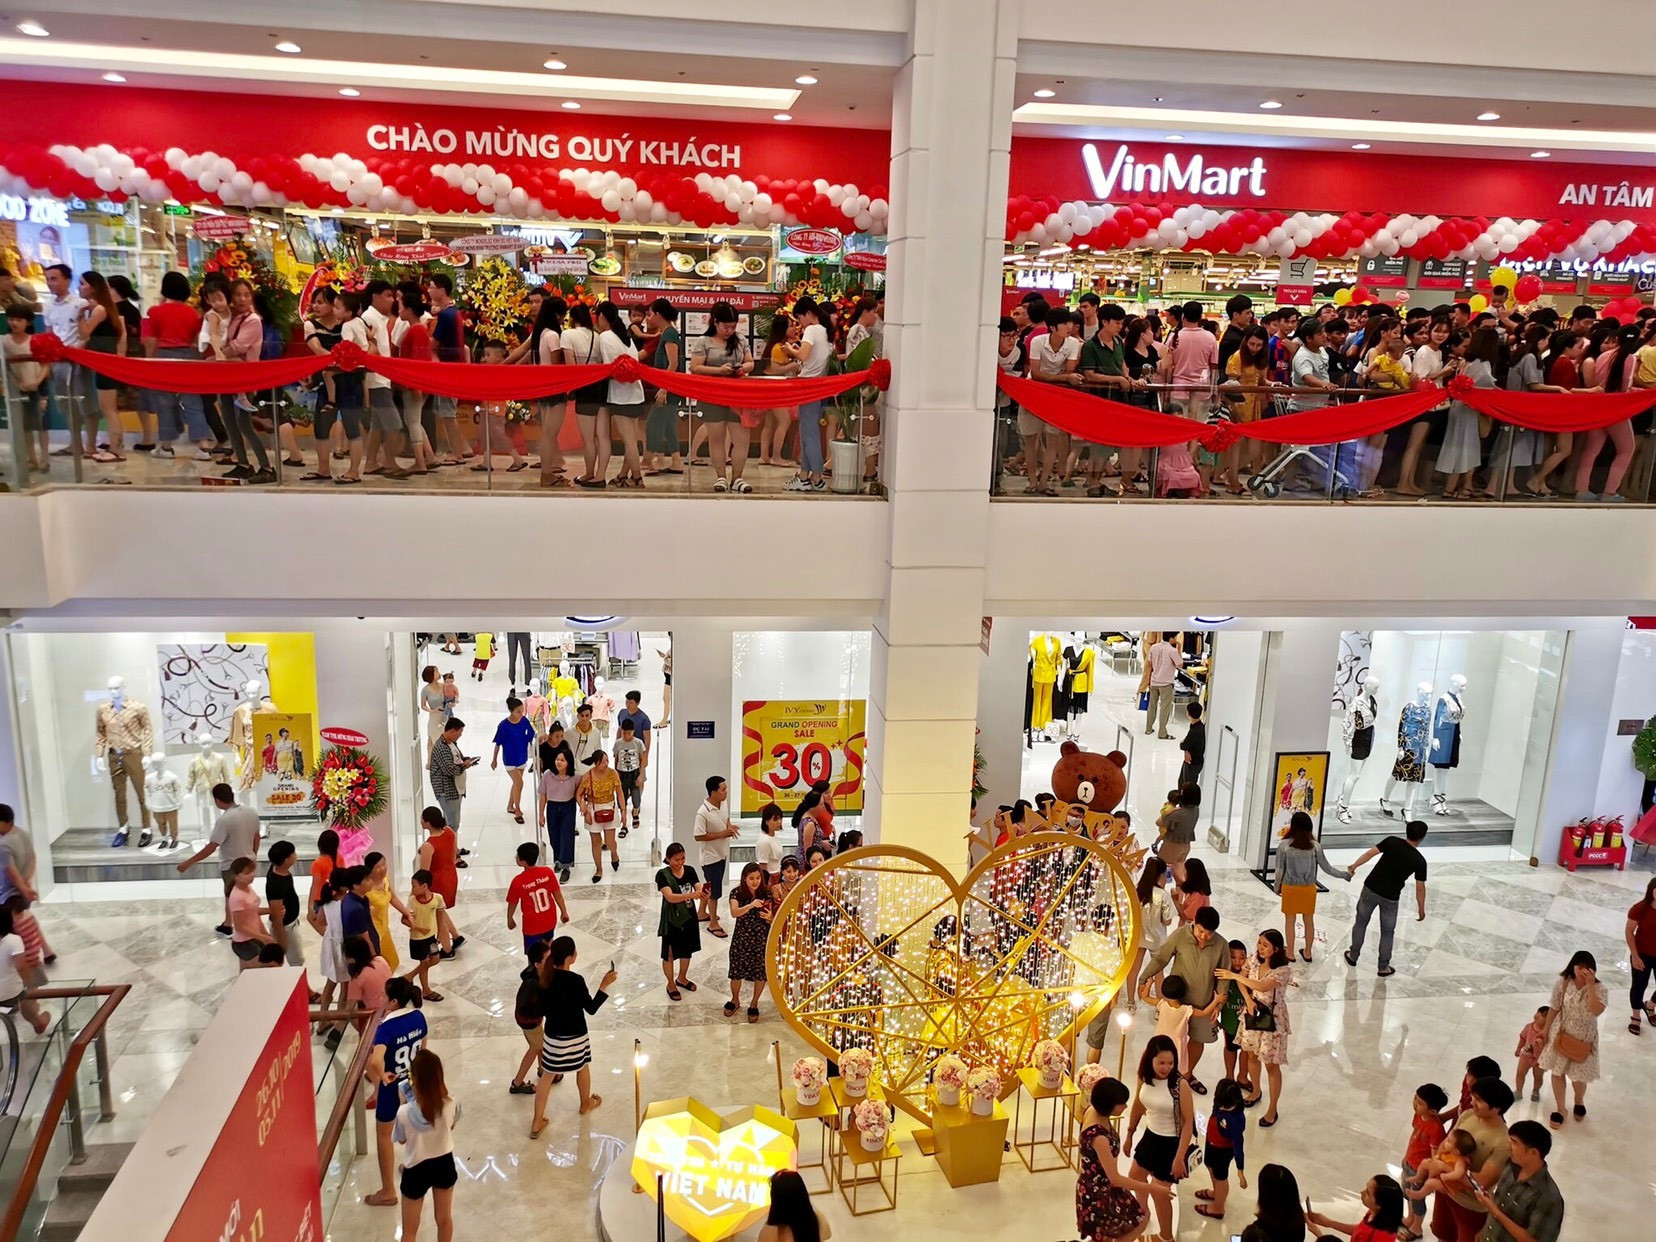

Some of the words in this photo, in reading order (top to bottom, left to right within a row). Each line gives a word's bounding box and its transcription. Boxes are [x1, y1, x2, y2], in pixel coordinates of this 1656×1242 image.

[366, 122, 457, 154] CHÀO
[465, 125, 561, 159] MỪNG
[567, 133, 633, 163] QUÝ
[640, 136, 741, 168] KHÁCH
[1081, 143, 1267, 199] VinMart
[1558, 183, 1598, 205] AN
[1602, 180, 1655, 208] TÂM
[794, 729, 815, 738] SALE
[768, 742, 832, 789] 30
[529, 888, 551, 914] 10
[655, 1170, 709, 1197] VIỆT
[716, 1177, 768, 1207] NAM
